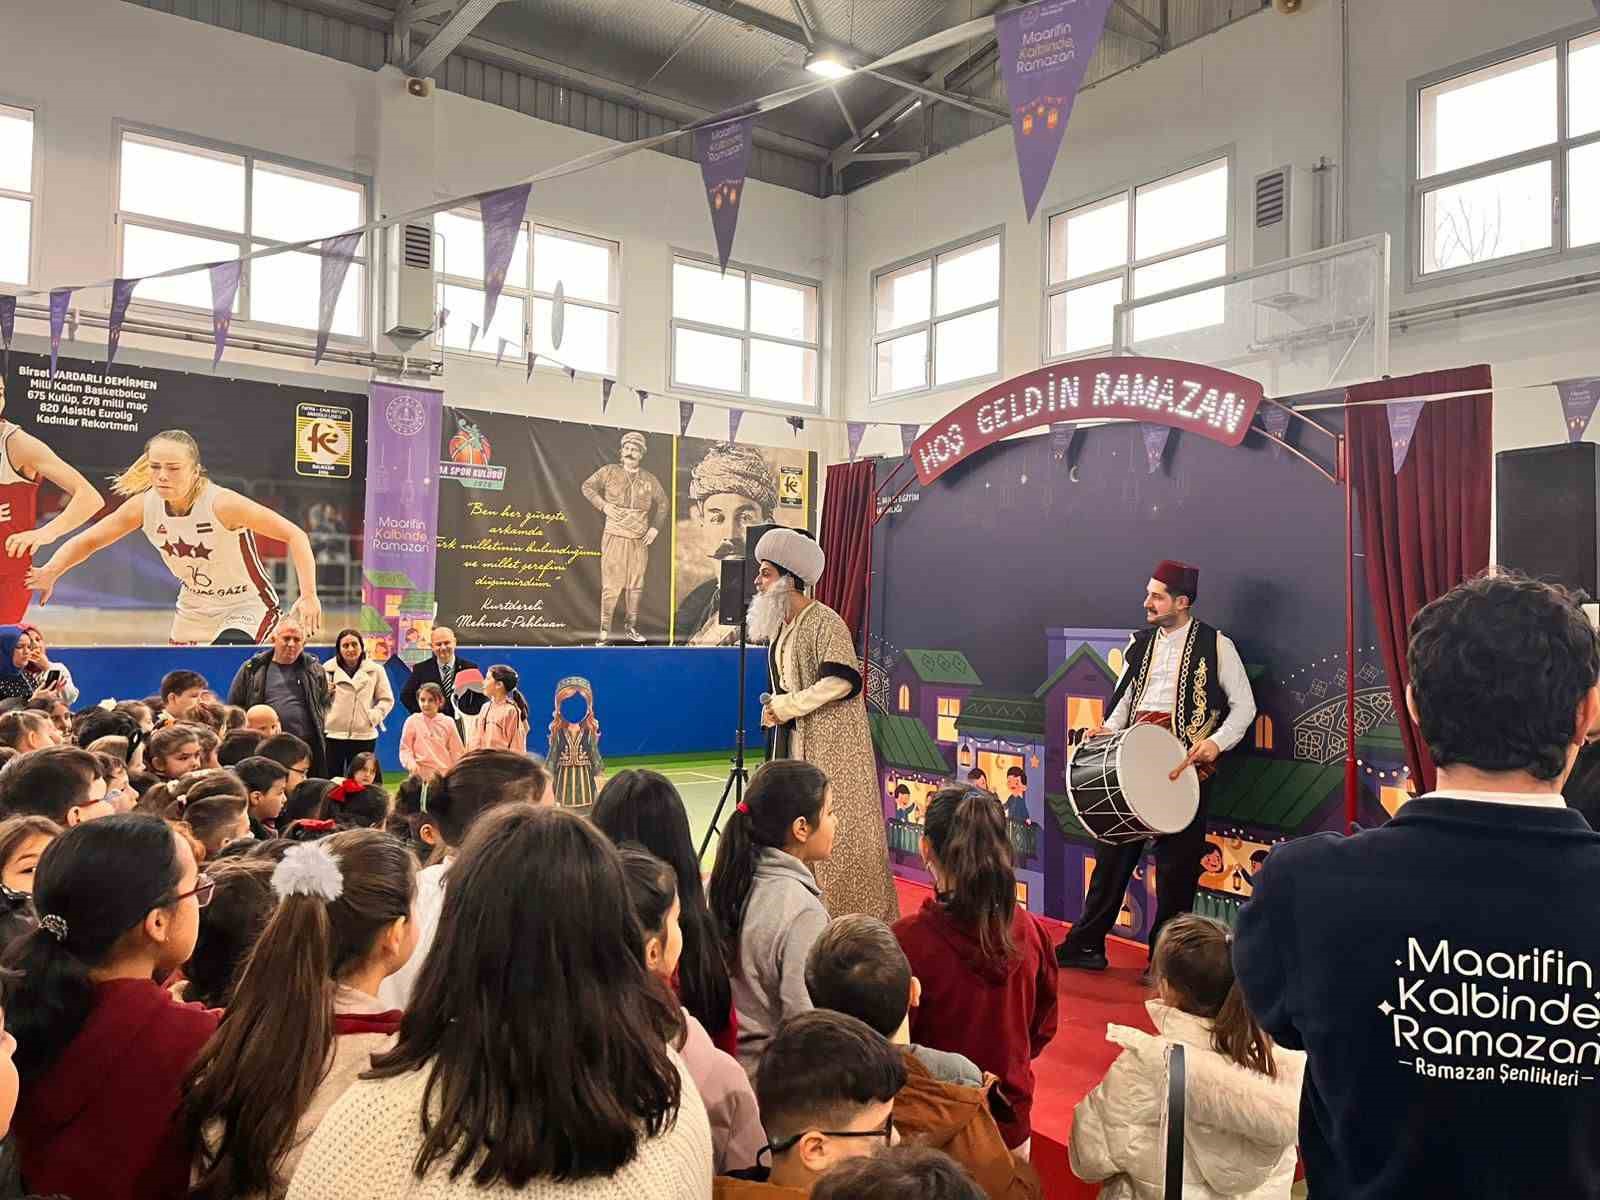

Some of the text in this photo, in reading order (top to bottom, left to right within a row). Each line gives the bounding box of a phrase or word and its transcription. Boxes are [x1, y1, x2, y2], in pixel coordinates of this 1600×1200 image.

[1016, 50, 1075, 73] Ramazan
[19, 366, 50, 378] Birsel
[104, 375, 157, 390] DEMİRMEN
[30, 379, 146, 400] Milli Kadın Basketbolcu
[27, 390, 46, 401] 675
[82, 395, 100, 406] 278
[126, 403, 148, 414] maç
[40, 403, 133, 422] 820 Asistle Eurolig
[36, 414, 138, 432] Kadınlar Rekortmeni
[919, 372, 1246, 475] HOŞ GELDİN RAMAZAN
[501, 505, 521, 518] her
[488, 523, 544, 536] arkamda
[482, 557, 521, 570] millet
[455, 614, 567, 630] Mehmet Pehlivan
[1408, 937, 1592, 988] Maarifin
[1398, 976, 1600, 1030] Kalbinde
[1392, 1014, 1600, 1065] Ramazan
[1500, 1063, 1579, 1087] Şenlikleri
